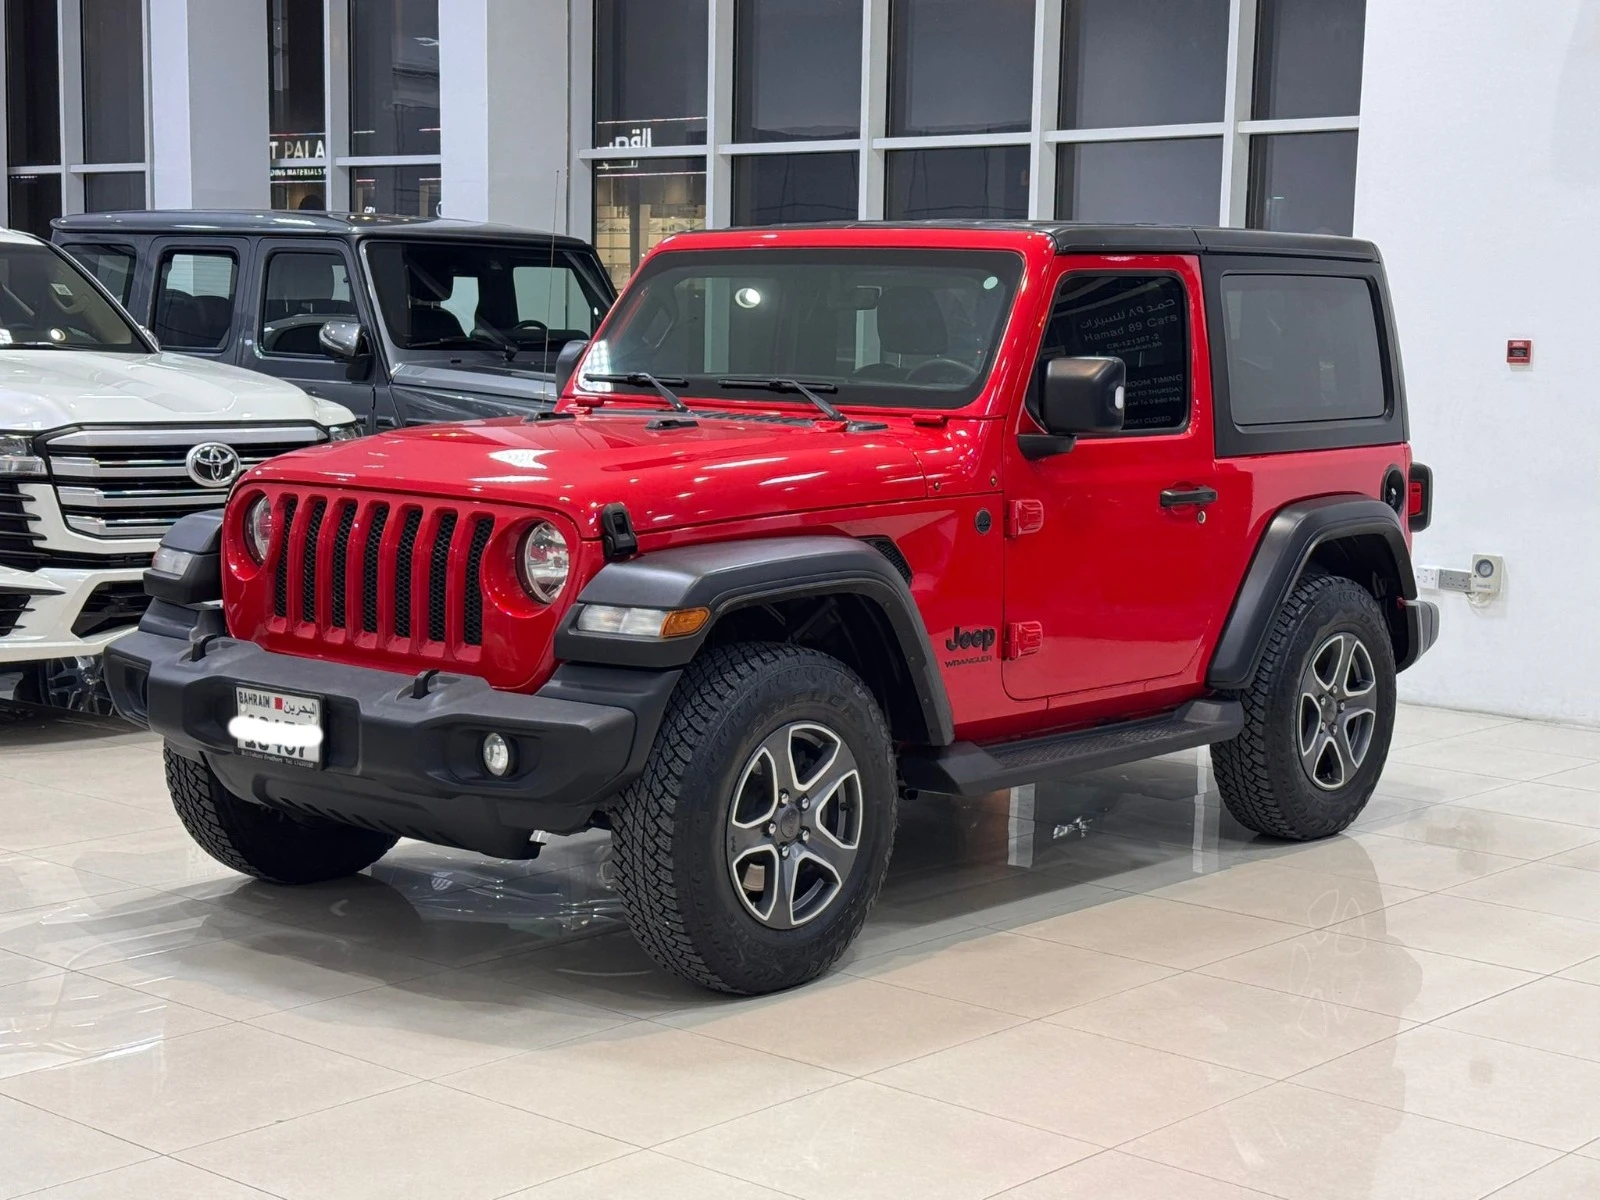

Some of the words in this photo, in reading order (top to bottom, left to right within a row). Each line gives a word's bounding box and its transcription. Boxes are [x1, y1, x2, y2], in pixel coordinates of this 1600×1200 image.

[286, 167, 322, 176] MATERIALS
[1083, 326, 1125, 342] Hamad
[1128, 321, 1143, 333] 89
[1146, 314, 1178, 328] Cars
[946, 626, 996, 652] Jeep
[944, 655, 993, 668] WRANGLER
[238, 692, 271, 709] BAHRAIN
[283, 702, 317, 719] البحرين
